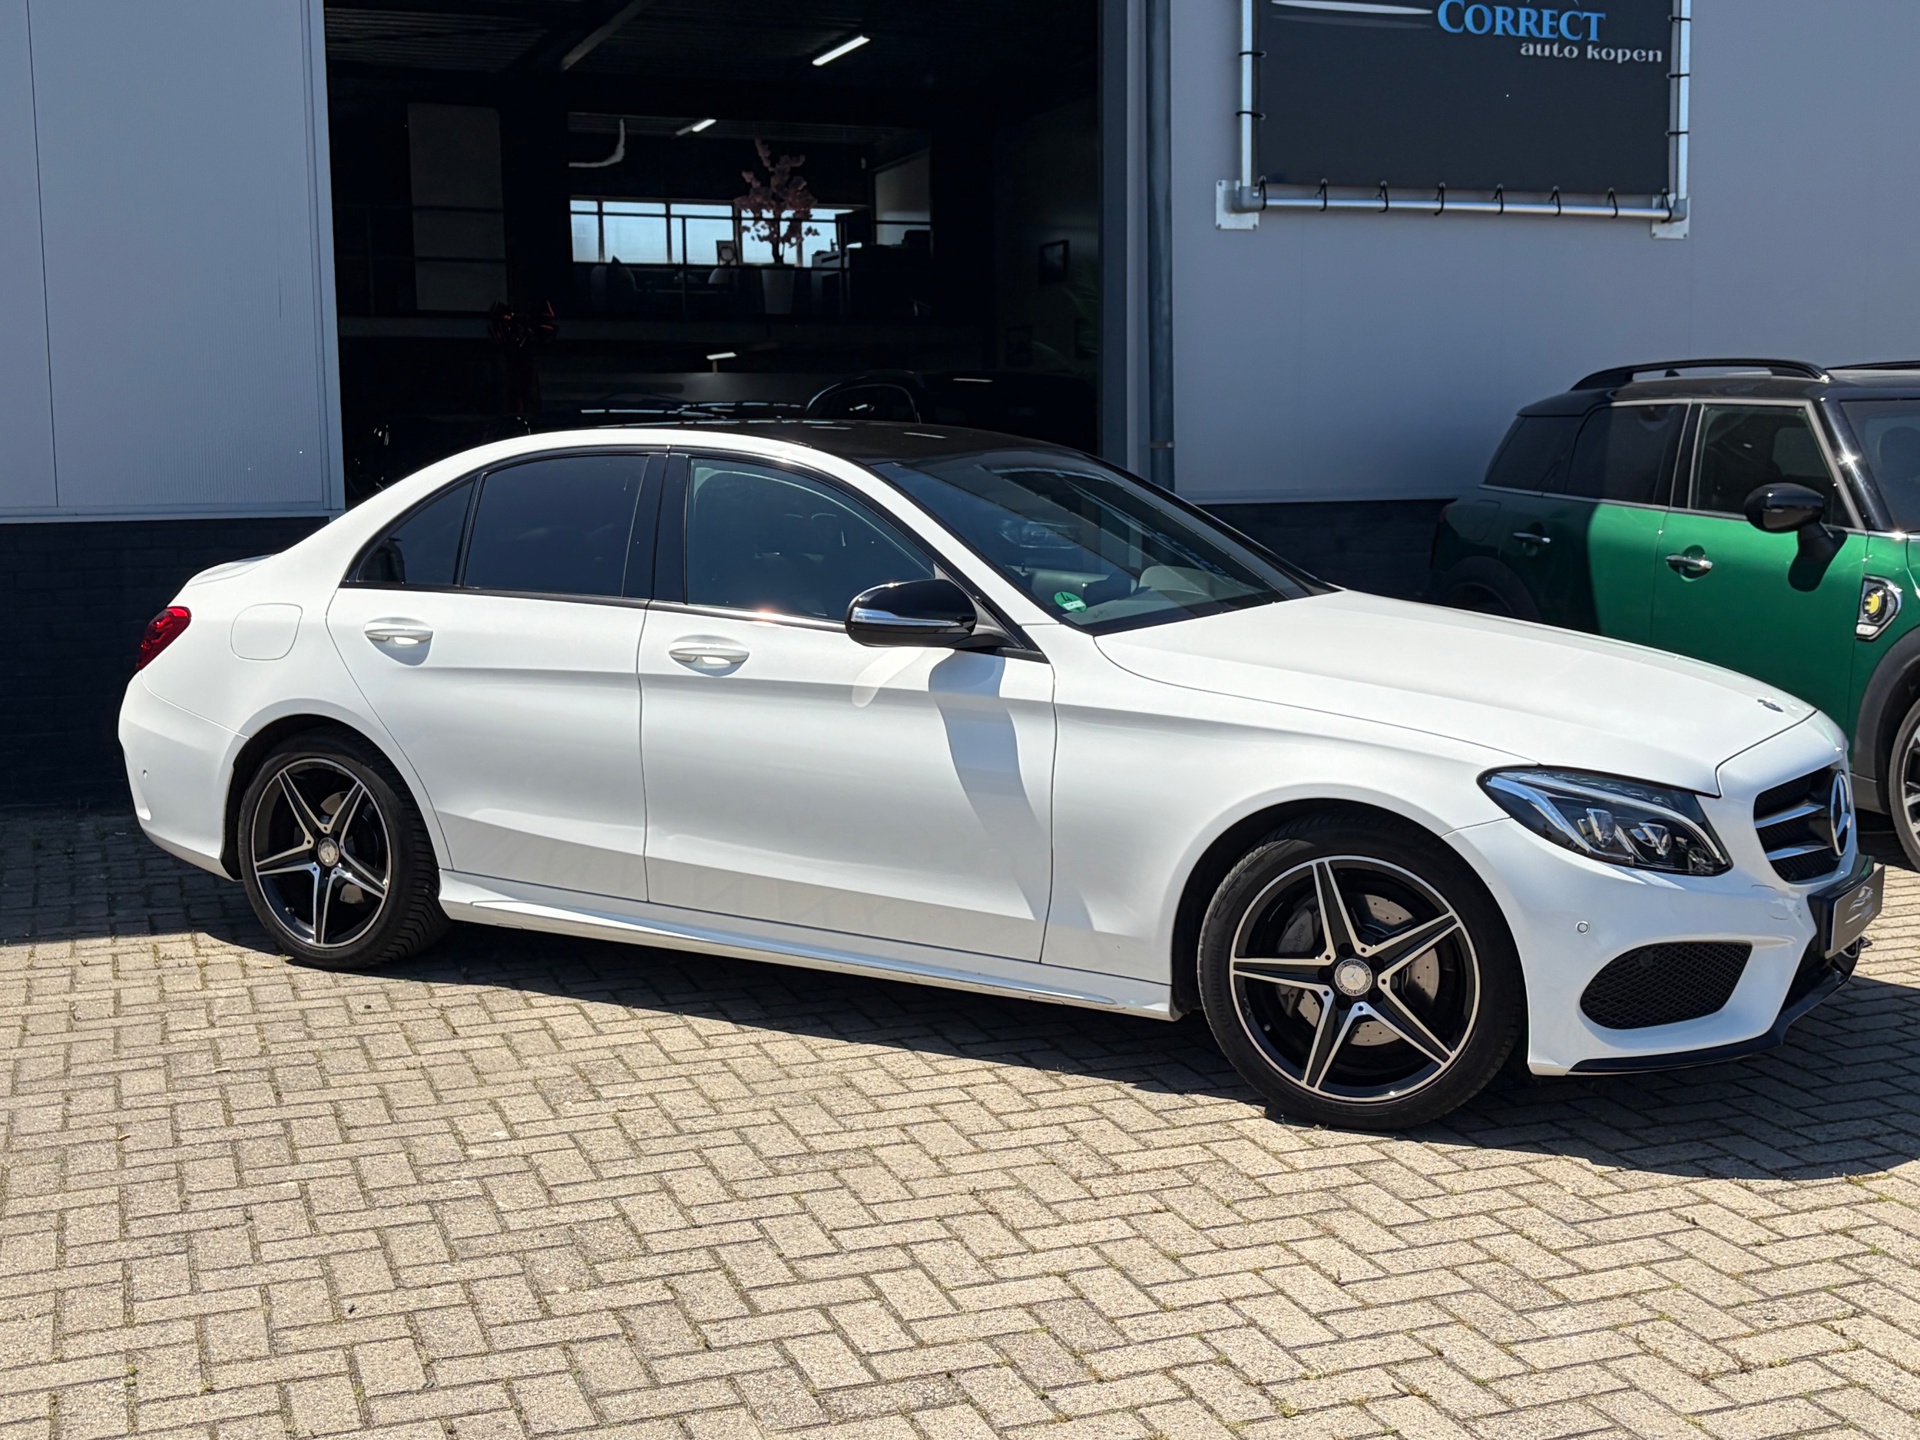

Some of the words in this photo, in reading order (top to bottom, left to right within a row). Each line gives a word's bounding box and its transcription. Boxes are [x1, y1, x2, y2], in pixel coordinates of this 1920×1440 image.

[1437, 0, 1606, 41] CORRECT
[1520, 42, 1579, 59] auto
[1587, 43, 1663, 64] kopen
